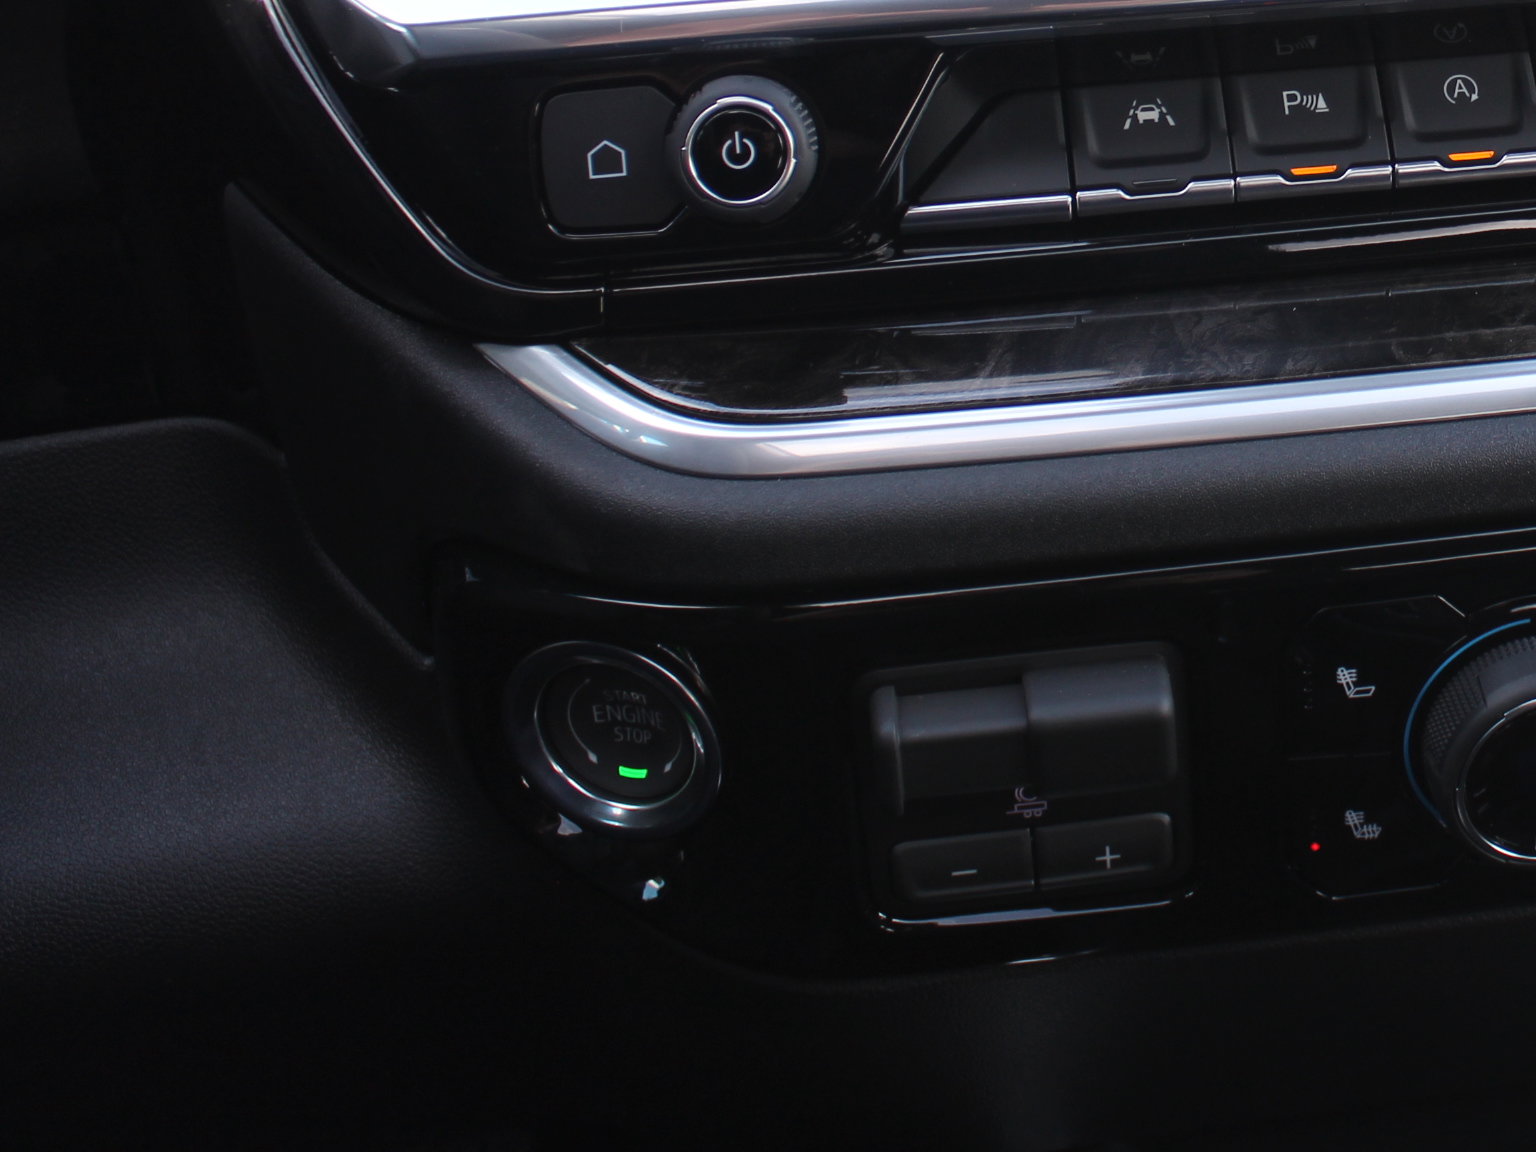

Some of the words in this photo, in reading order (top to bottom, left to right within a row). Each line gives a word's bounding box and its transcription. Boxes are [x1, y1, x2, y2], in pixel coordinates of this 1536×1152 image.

[603, 689, 647, 705] START
[592, 704, 664, 731] ENGINE
[613, 726, 653, 744] STOP
